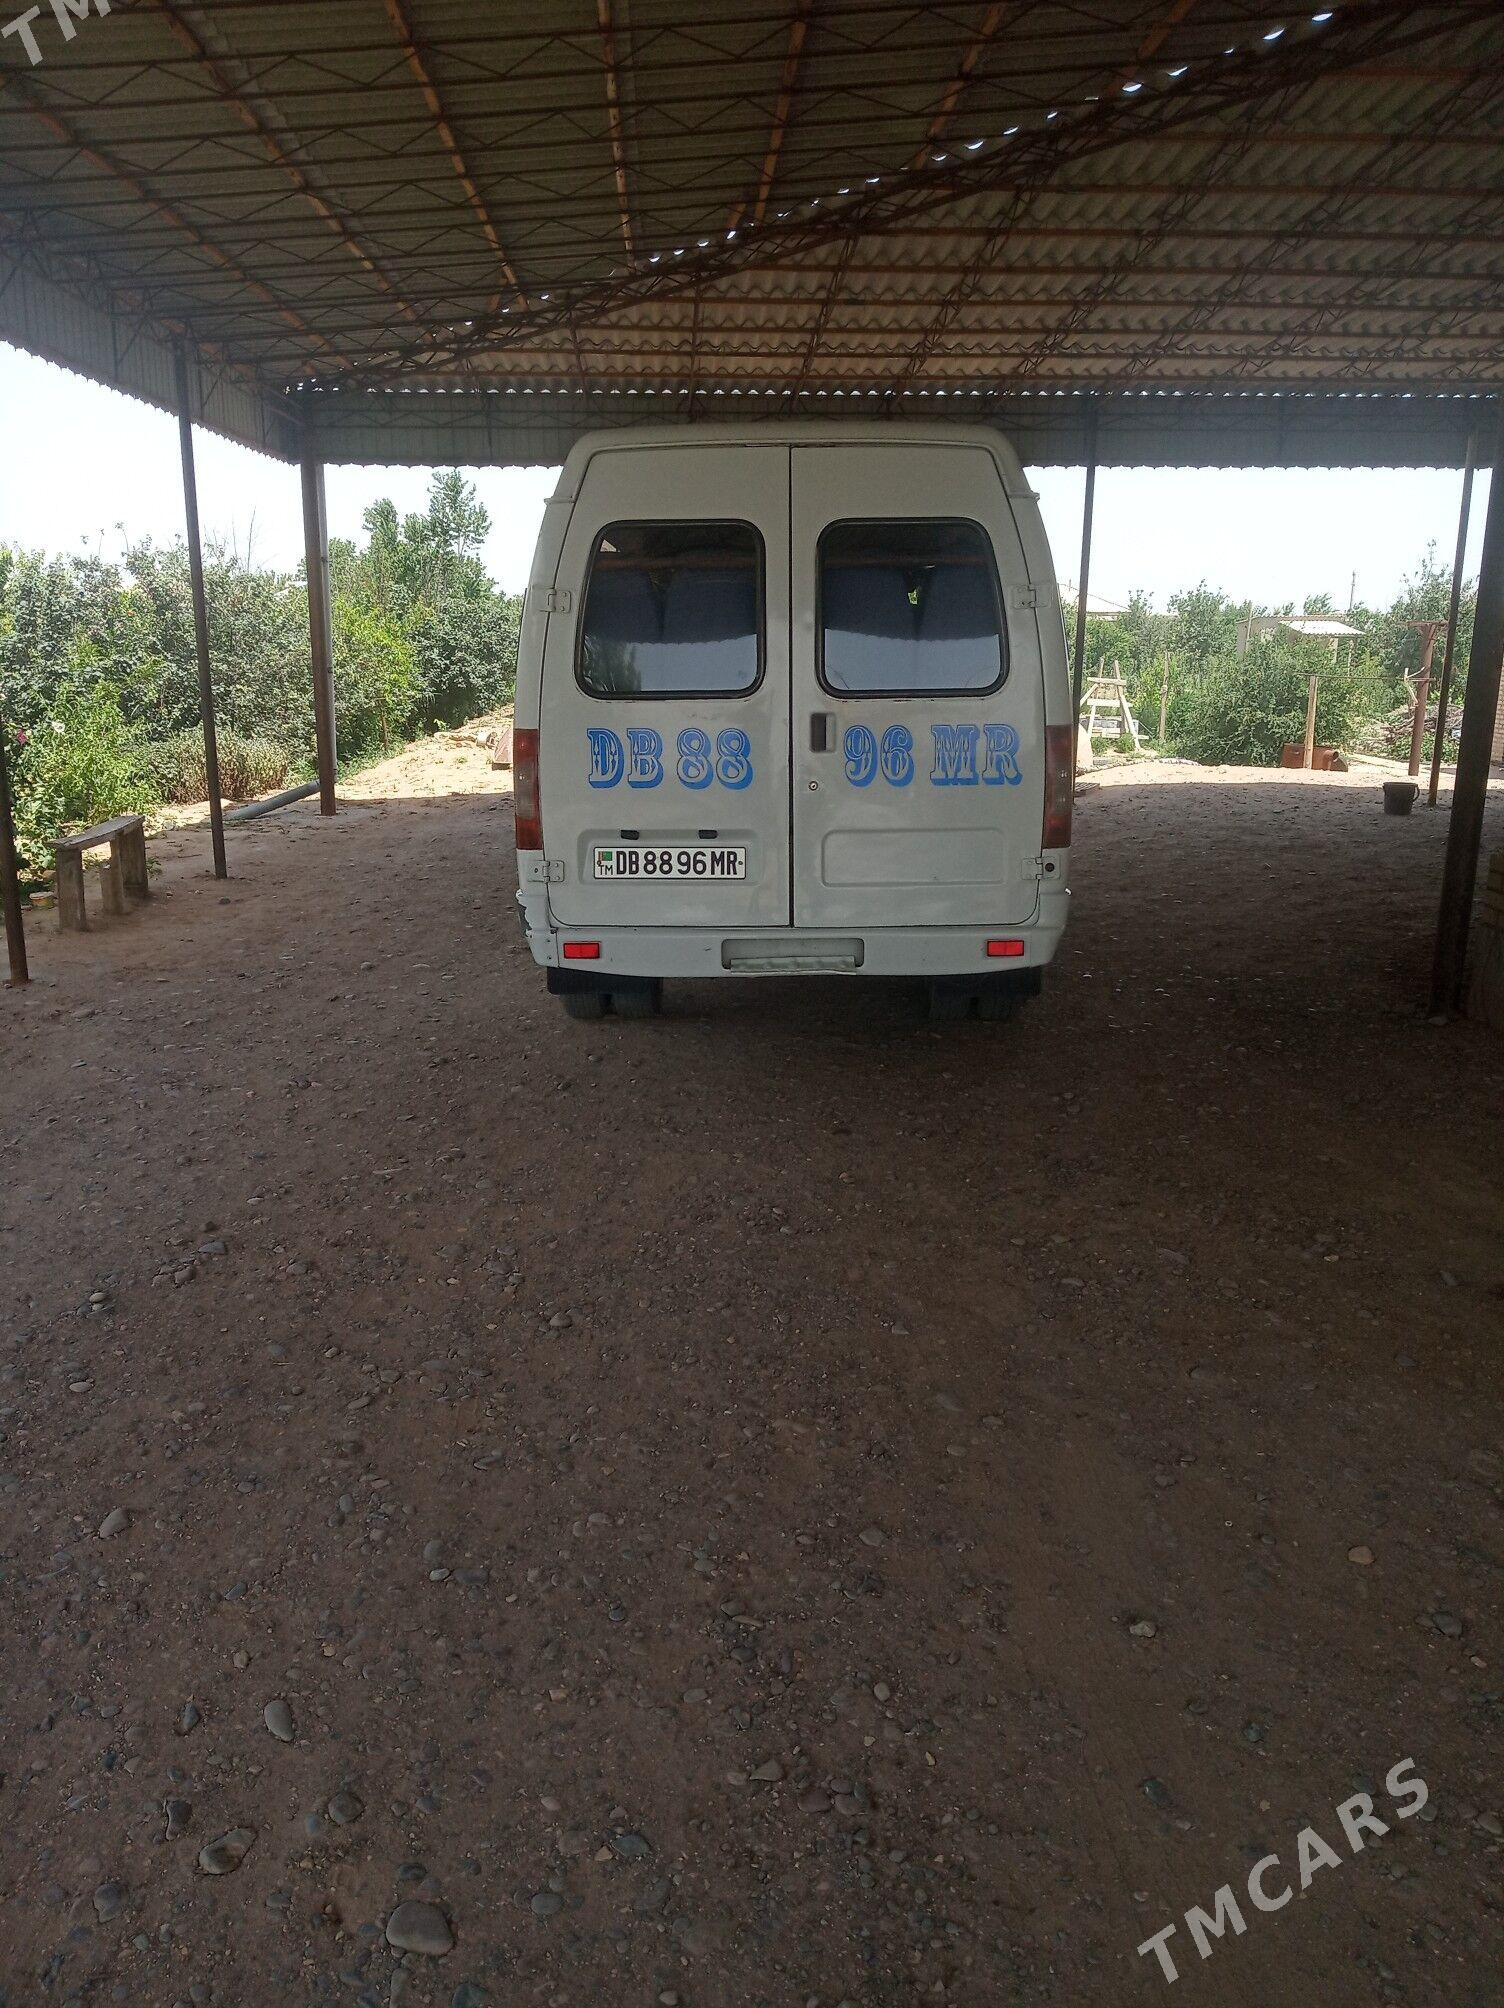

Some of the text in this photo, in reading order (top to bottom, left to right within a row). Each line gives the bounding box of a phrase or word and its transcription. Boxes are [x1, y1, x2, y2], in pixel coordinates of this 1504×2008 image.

[587, 723, 1023, 791] DB 88 96 MR
[599, 864, 613, 876] TM
